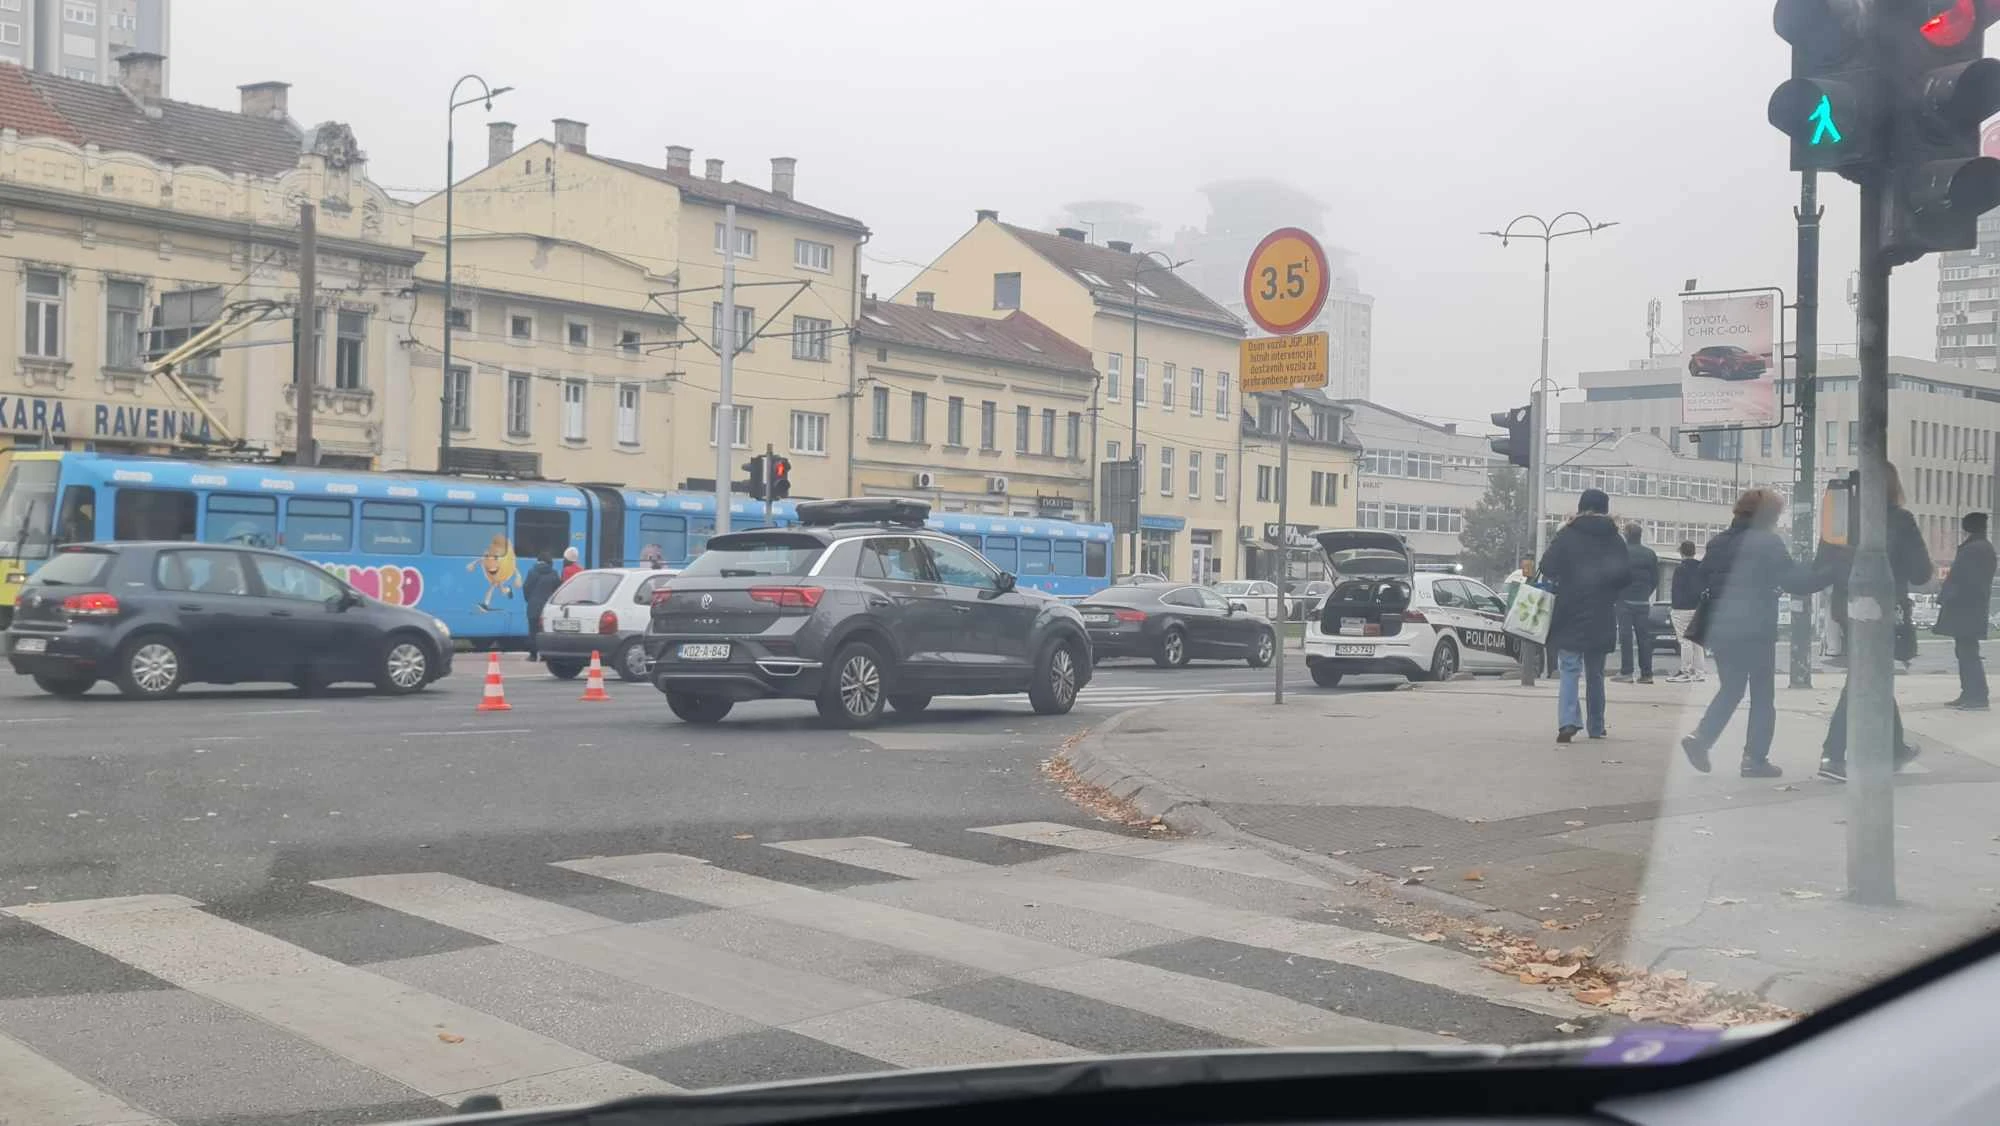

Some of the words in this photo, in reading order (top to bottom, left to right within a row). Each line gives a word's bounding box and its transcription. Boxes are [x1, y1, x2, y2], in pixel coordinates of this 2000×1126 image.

[1688, 314, 1728, 326] TOYOTA
[1688, 327, 1715, 337] C-HR
[1250, 363, 1284, 375] dostavnih
[1286, 360, 1306, 371] vozila
[1308, 361, 1317, 371] za
[1243, 375, 1288, 389] prehrambene
[1290, 372, 1324, 385] proizvode
[95, 404, 212, 441] RAVENNA
[1465, 630, 1506, 648] POLICIJA
